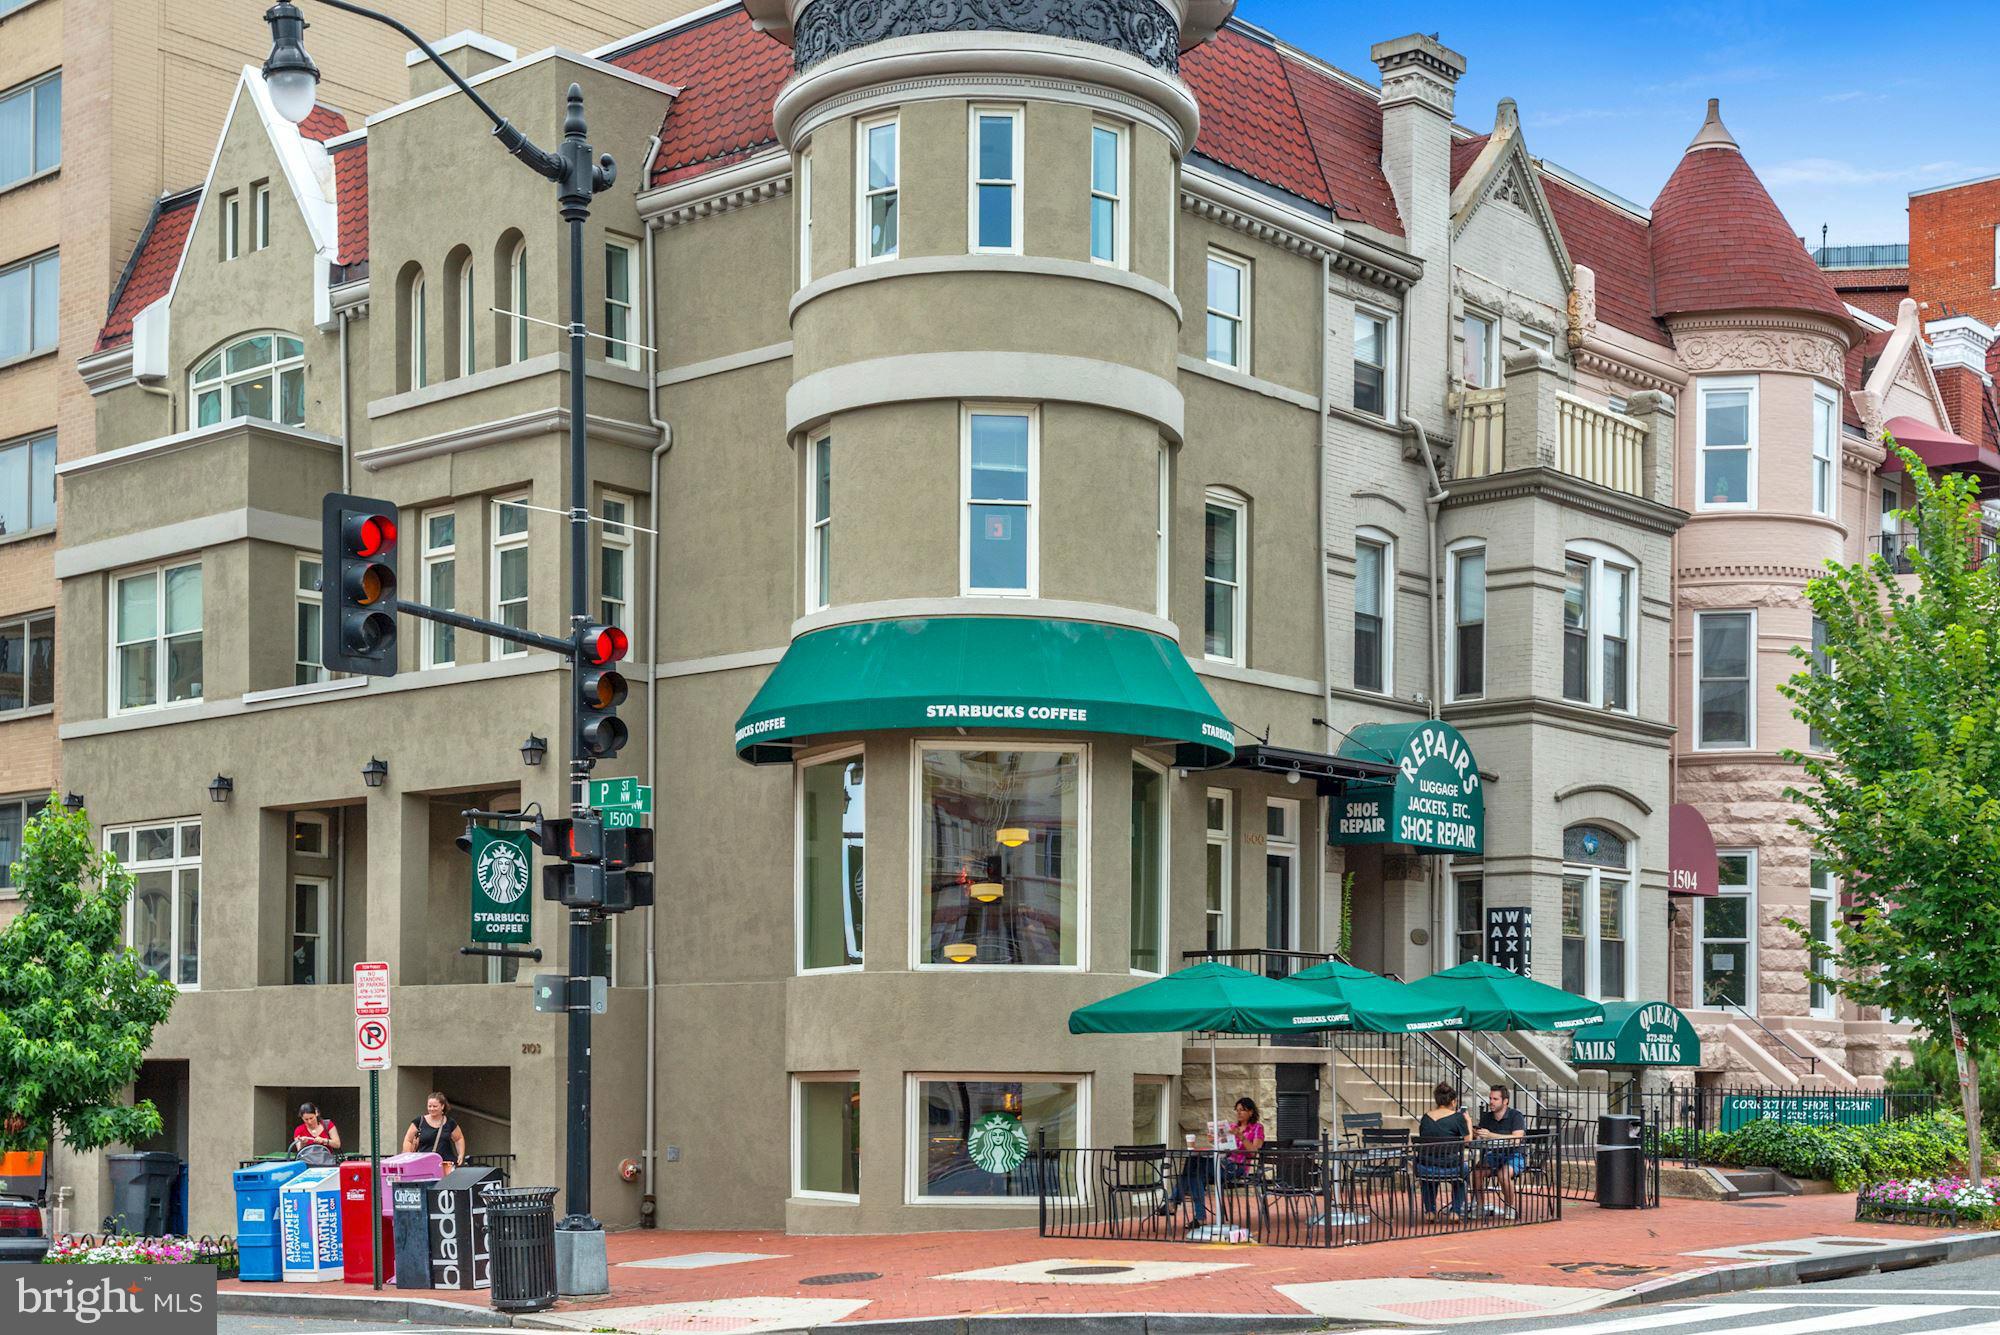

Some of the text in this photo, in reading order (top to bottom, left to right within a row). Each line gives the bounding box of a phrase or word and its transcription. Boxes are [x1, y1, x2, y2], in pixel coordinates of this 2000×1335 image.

[926, 705, 1087, 721] STARBUCKS COFFEE
[755, 716, 786, 734] COFFEE
[1201, 722, 1235, 747] STARBUCK
[1400, 728, 1479, 796] REPAIRS
[601, 783, 609, 803] P
[621, 780, 630, 791] ST
[636, 789, 642, 799] T
[1419, 779, 1459, 797] LUGGAGE
[620, 791, 630, 803] NW
[1346, 802, 1379, 818] SHOE
[1408, 796, 1471, 819] JACKETS, ETC.
[609, 811, 634, 827] 1500
[1340, 817, 1386, 834] REPAIR
[1401, 815, 1476, 848] SHOE REPAIR
[1673, 869, 1698, 890] 1504
[474, 912, 530, 923] STARBUCKS
[485, 923, 524, 933] COFFEE
[1505, 911, 1519, 952] WAX
[1490, 911, 1503, 967] NAIL
[1524, 913, 1532, 978] NAILS
[1292, 1015, 1327, 1025] STARBUCKS
[1639, 1004, 1680, 1033] QUEEN
[1574, 1040, 1616, 1061] NAILS
[1639, 1042, 1681, 1063] NAILS
[1732, 1099, 1873, 1111] CORRECTIVE SHOE REPAIR
[284, 1198, 296, 1263] APARTMENT
[318, 1197, 331, 1263] APARTMENT
[430, 1189, 460, 1290] blade
